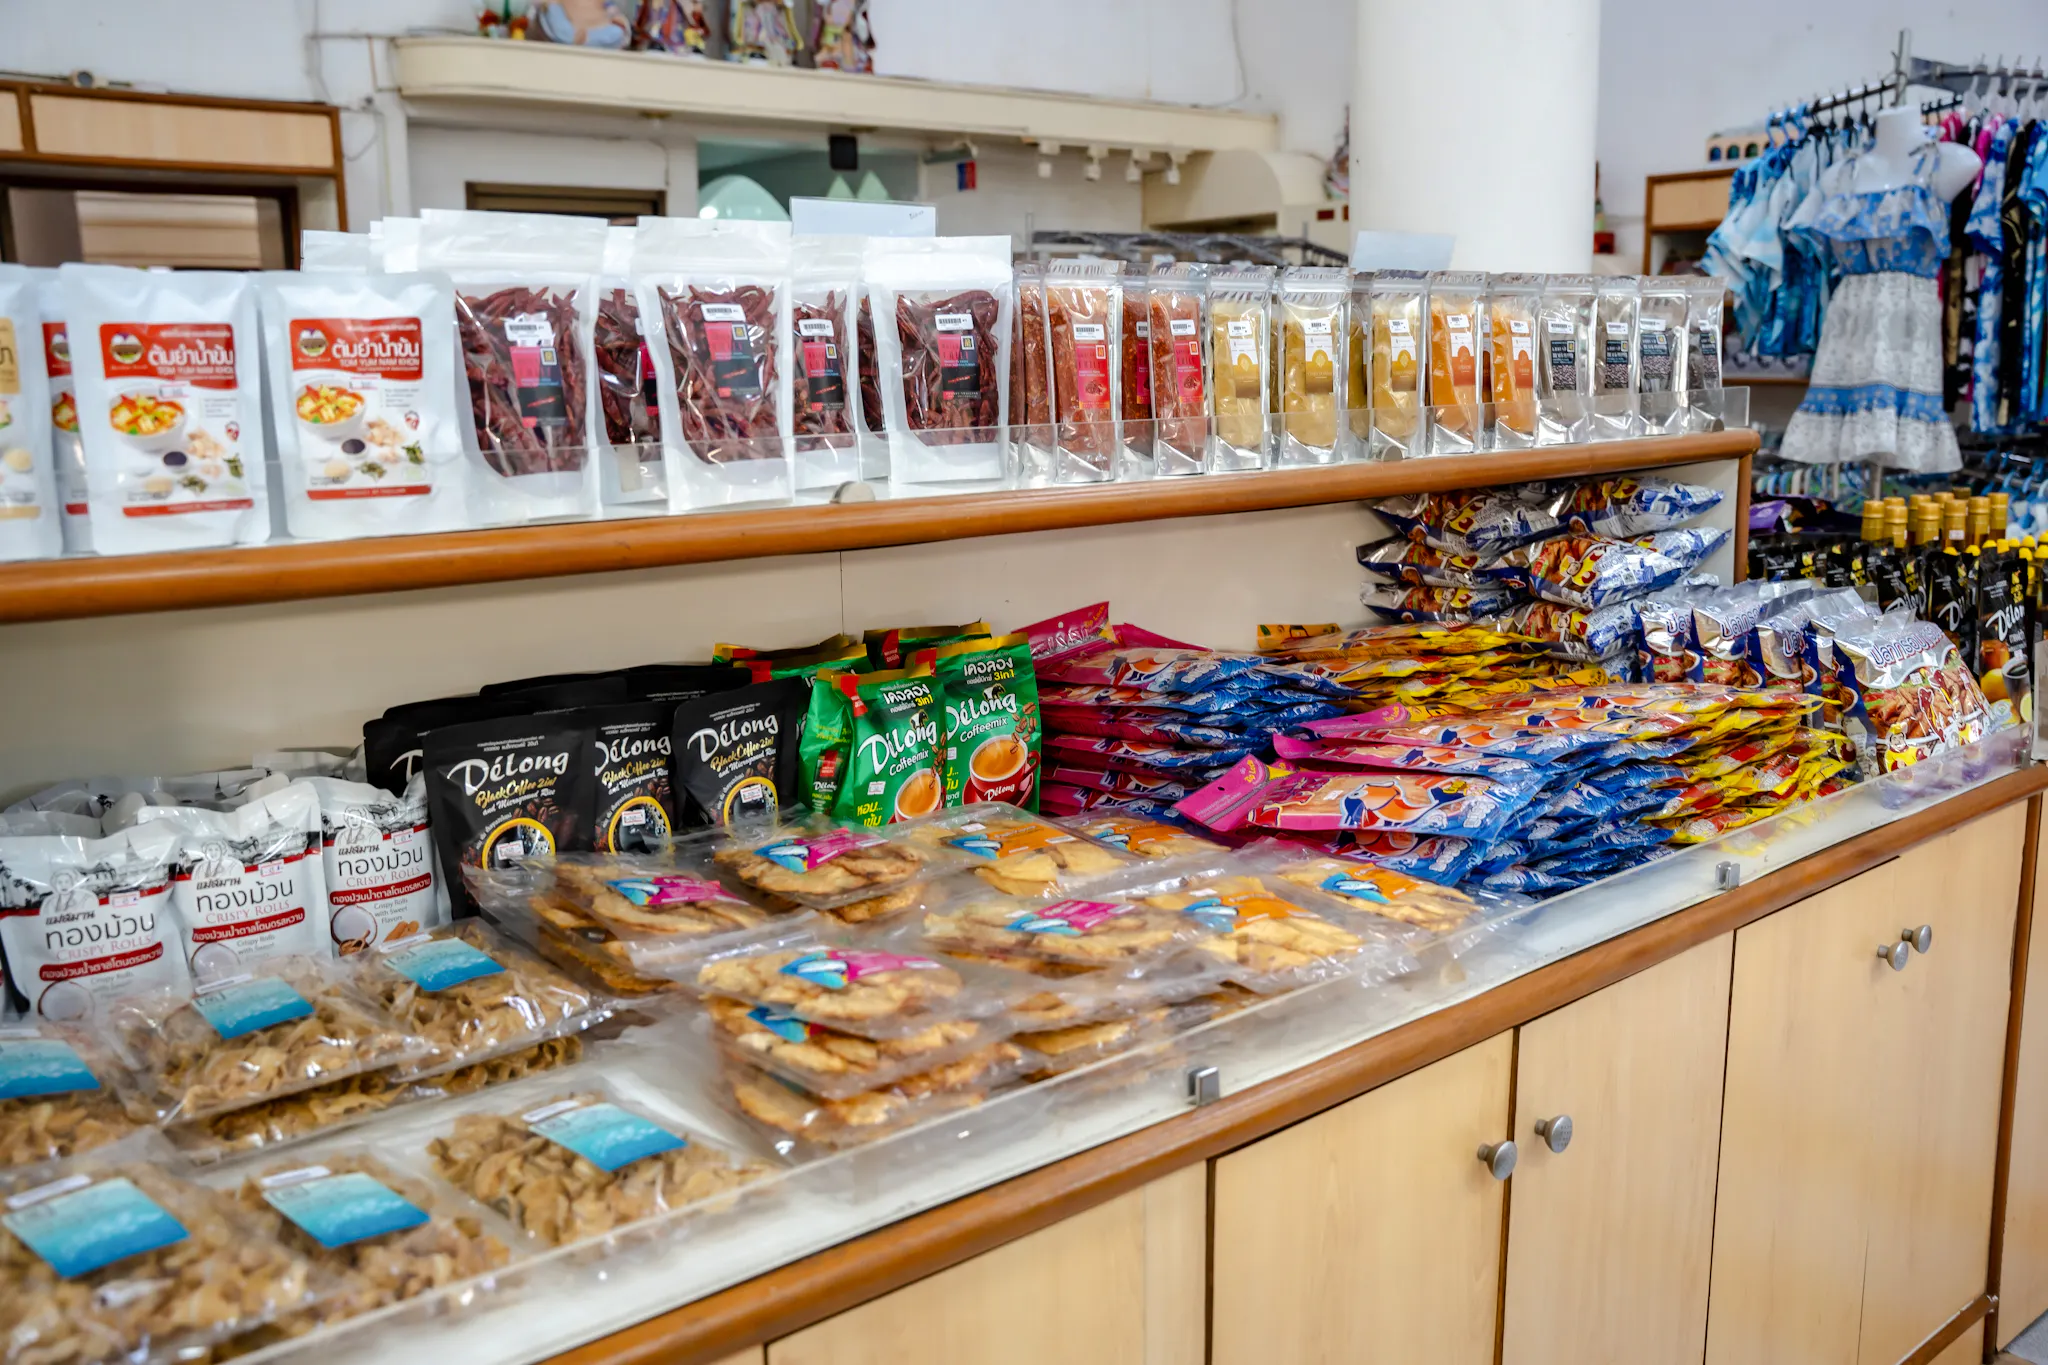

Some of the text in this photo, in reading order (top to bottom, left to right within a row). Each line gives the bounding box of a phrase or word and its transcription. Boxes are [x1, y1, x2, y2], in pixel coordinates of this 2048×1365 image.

[147, 338, 235, 367] ต้มยำน้ำข้น
[331, 332, 420, 359] ต้มยำน้ำข้น
[1985, 605, 2025, 642] Délon
[963, 656, 1014, 677] เดอลอง
[994, 671, 1015, 682] 3in1
[882, 683, 930, 705] เดอลอง
[915, 694, 934, 707] 3in1
[687, 714, 779, 762] Délong
[959, 716, 1008, 744] Coffeemix
[710, 751, 738, 772] Black
[737, 741, 760, 760] Coffee
[889, 749, 929, 777] Coffeemix
[447, 752, 569, 796] Délong
[602, 768, 627, 789] Black
[626, 761, 650, 779] Coffee
[475, 789, 507, 809] Black
[506, 779, 537, 799] Coffee
[338, 846, 424, 876] ทองม้วน
[346, 866, 420, 888] CRISPY ROLLS
[196, 879, 293, 912] ทองม้วน
[206, 900, 290, 925] CRISPY ROLLS
[46, 913, 155, 949] ทองม้วน
[56, 935, 152, 962] CRISPY ROLLS
